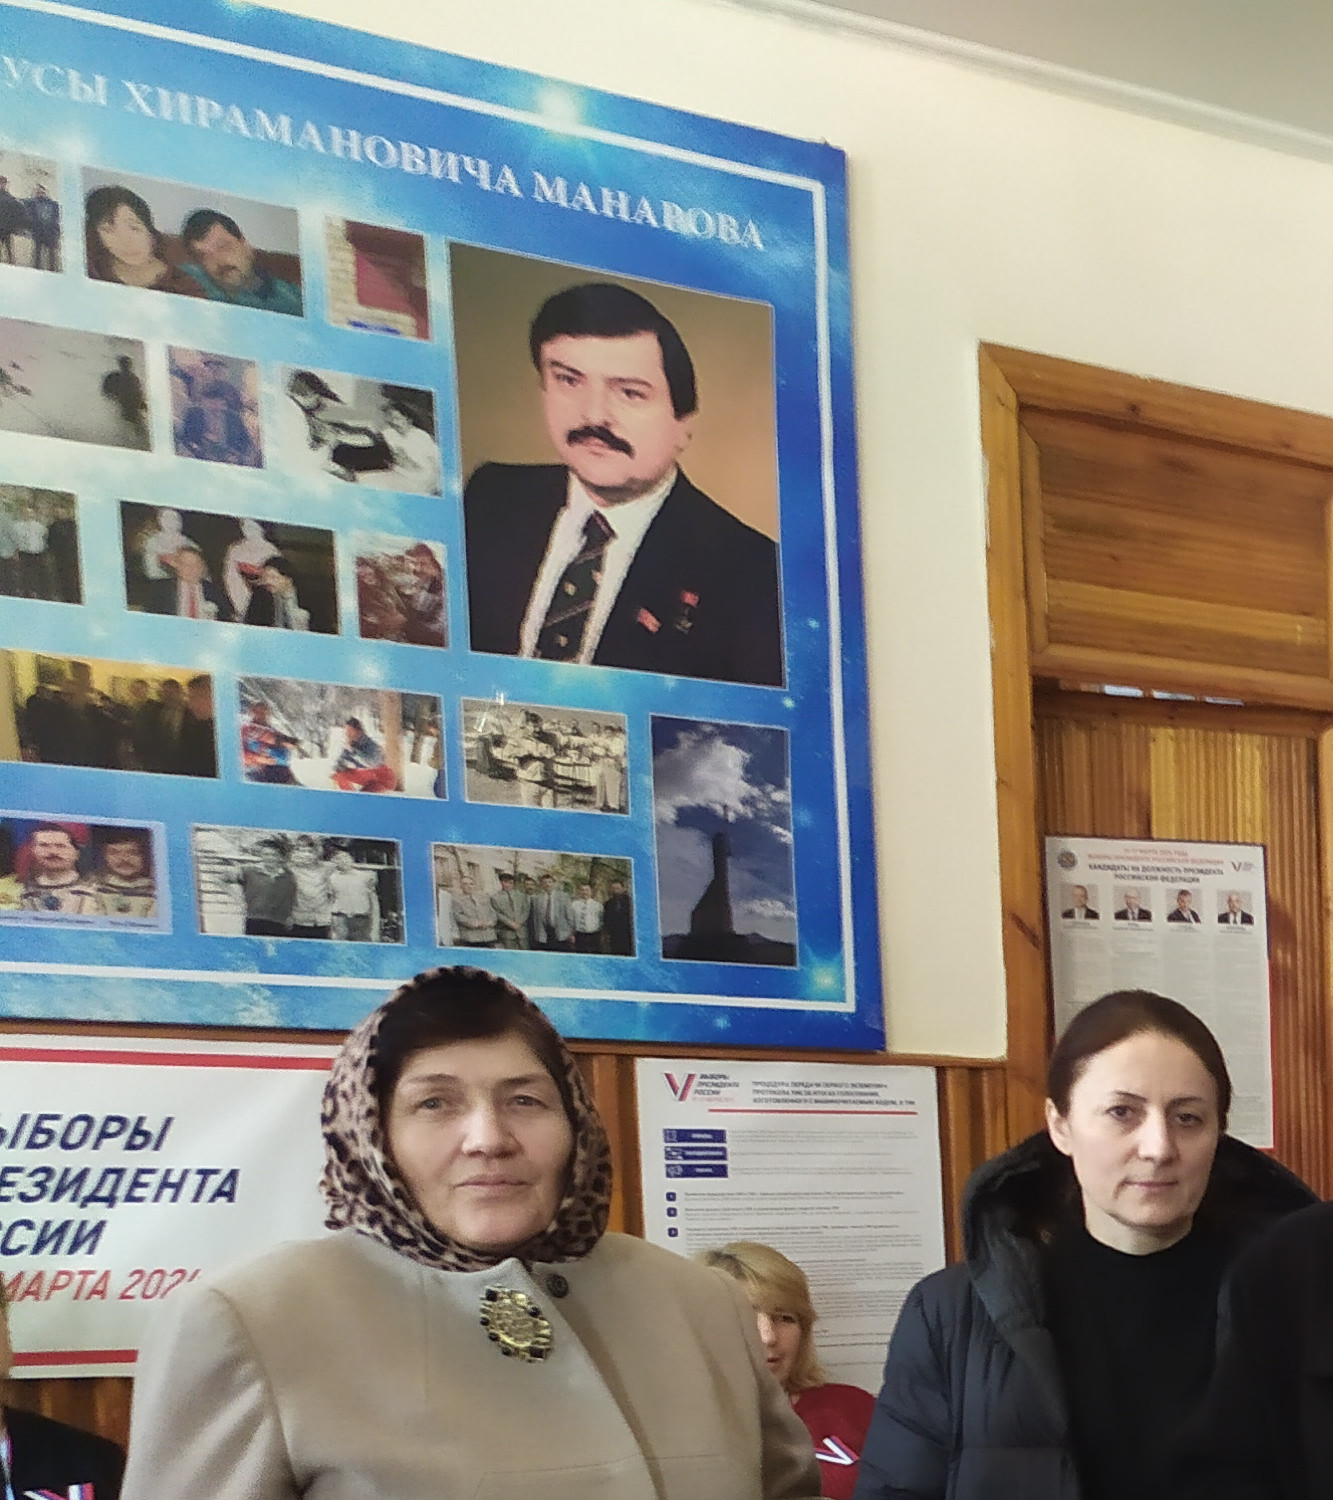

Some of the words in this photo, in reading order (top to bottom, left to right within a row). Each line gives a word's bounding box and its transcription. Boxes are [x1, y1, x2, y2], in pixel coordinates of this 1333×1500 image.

[1, 55, 108, 107] УСЫ
[121, 79, 525, 200] ХИРАМАНОВИЧА
[532, 170, 766, 252] МАНАРОВА
[0, 1166, 241, 1209] ЕЗИДЕНТА
[119, 1267, 201, 1301] 202
